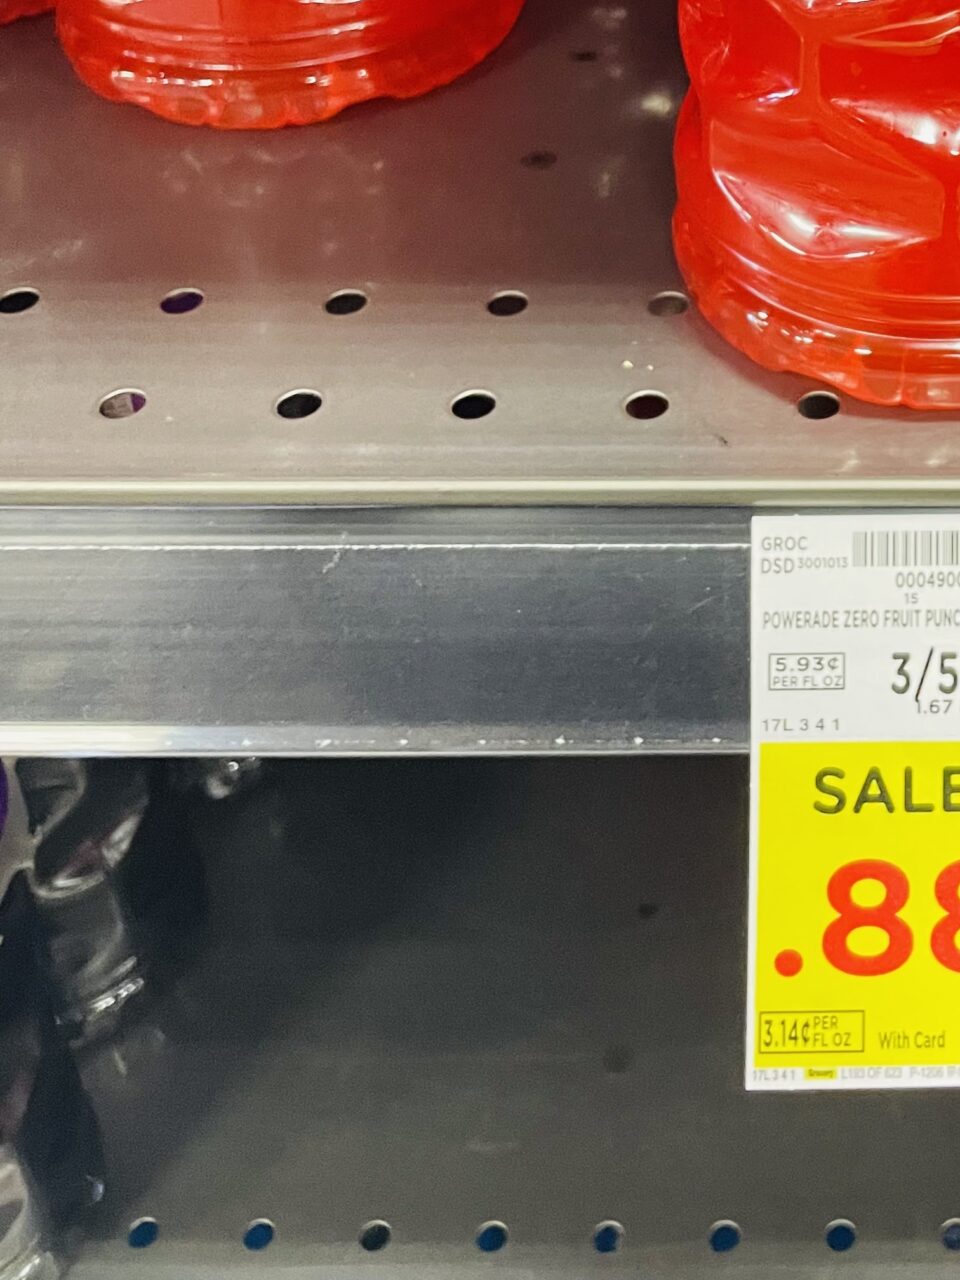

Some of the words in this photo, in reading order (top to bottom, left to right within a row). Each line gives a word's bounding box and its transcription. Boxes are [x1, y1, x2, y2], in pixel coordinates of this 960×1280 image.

[761, 536, 808, 551] GROC
[761, 558, 795, 574] DSD
[762, 610, 840, 629] POWERADE
[843, 609, 879, 628] ZERO
[884, 609, 921, 628] FRUIT
[775, 656, 840, 673] 5.93¢
[773, 675, 798, 688] PER
[802, 675, 819, 687] FL
[823, 675, 843, 687] OZ
[915, 699, 953, 715] 1.67
[762, 718, 793, 732] 17L
[763, 1020, 810, 1048] 3.14¢
[813, 1015, 838, 1030] PER
[812, 1033, 828, 1047] FL
[833, 1032, 851, 1047] OZ
[878, 1031, 910, 1049] With
[914, 1031, 946, 1048] Card
